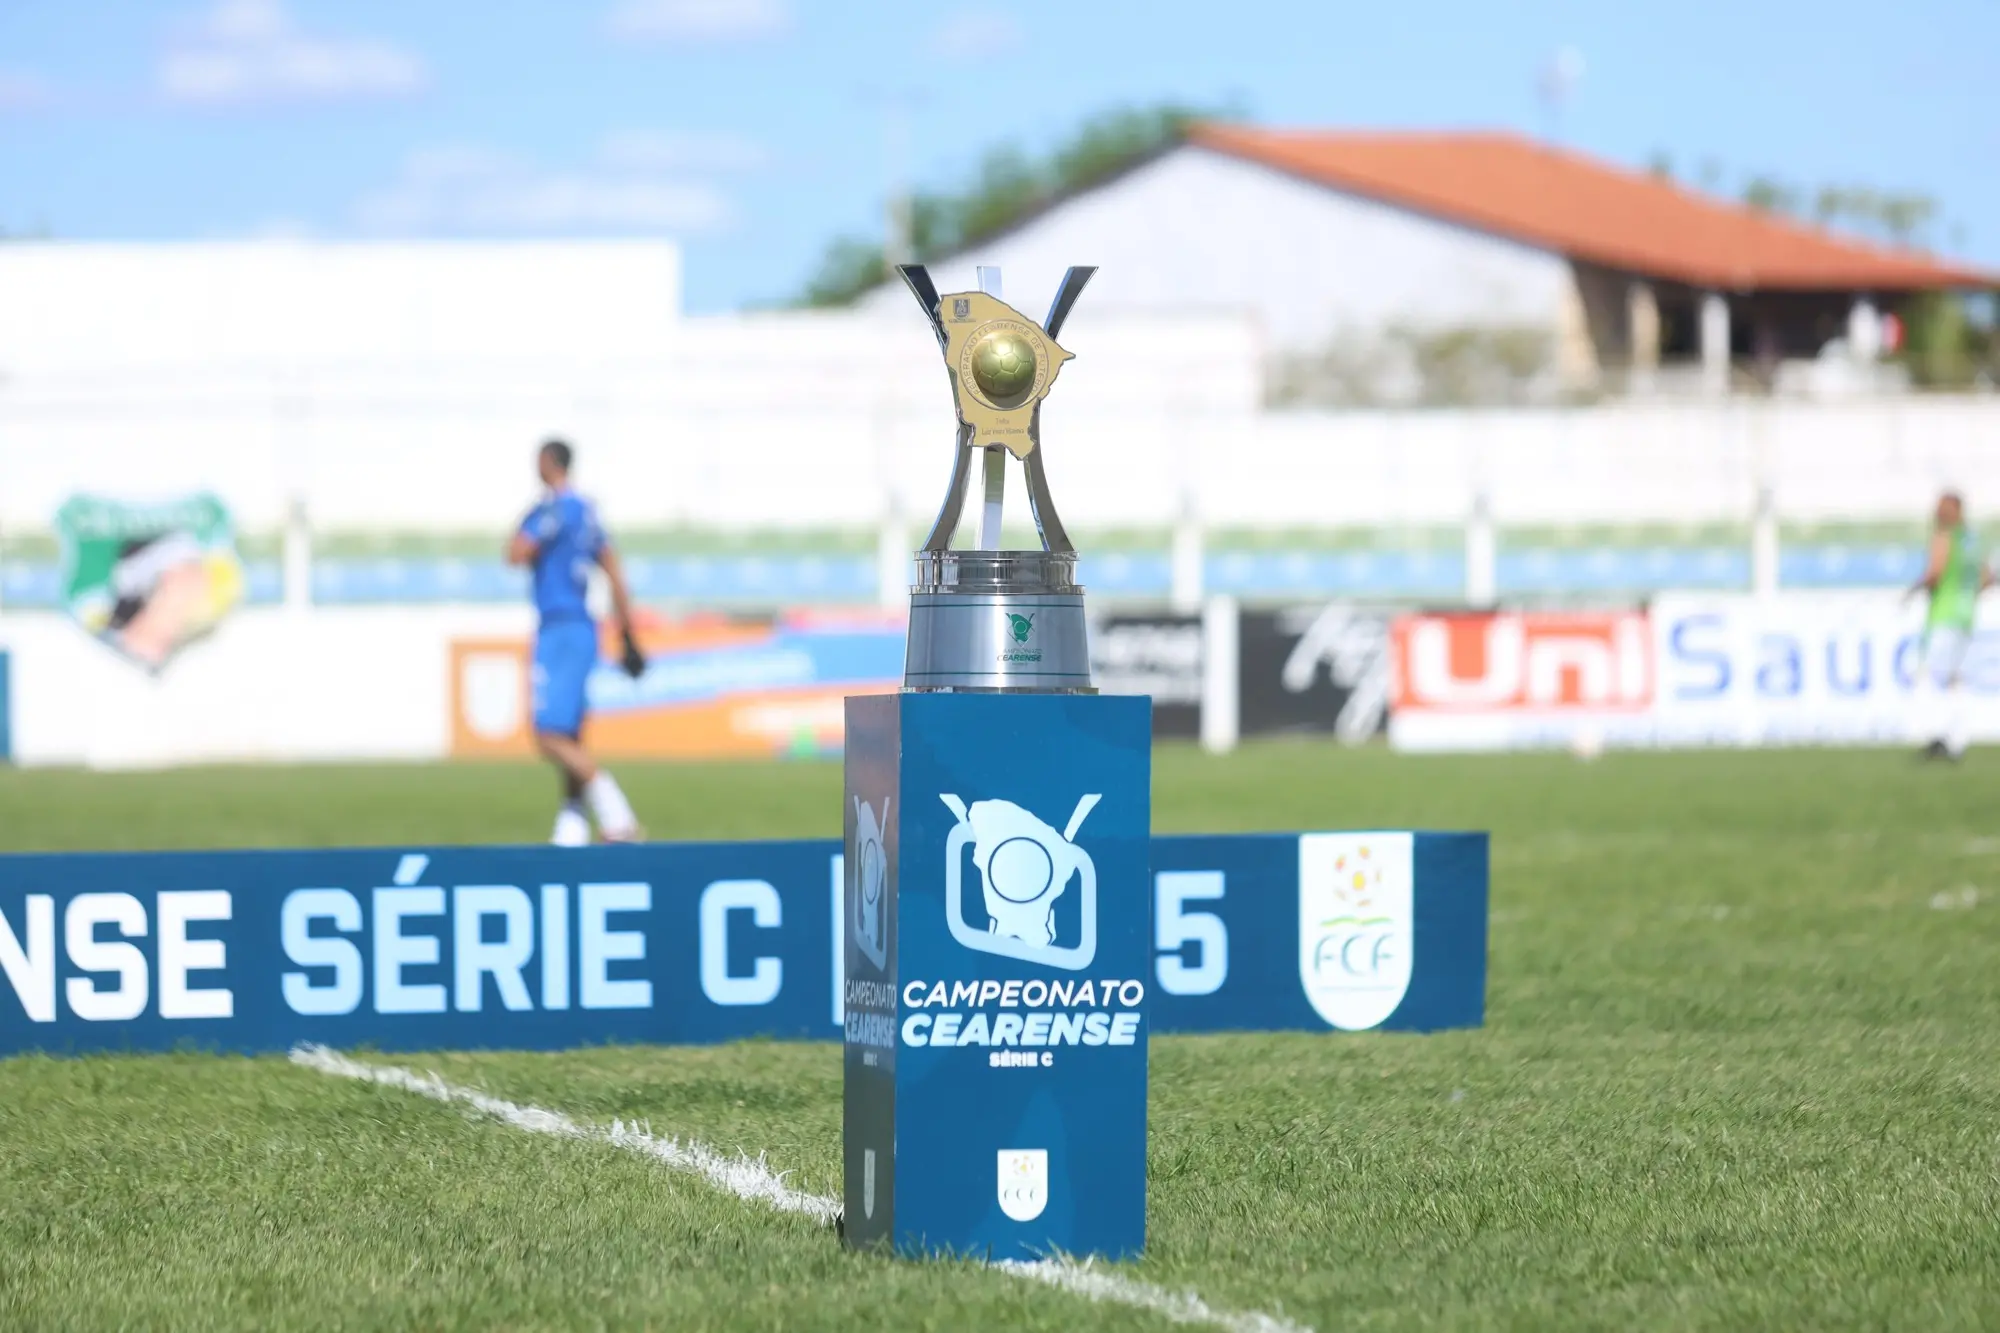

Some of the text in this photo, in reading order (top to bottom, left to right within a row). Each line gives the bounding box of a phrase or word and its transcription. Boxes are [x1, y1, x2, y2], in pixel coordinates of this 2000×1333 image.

[0, 854, 1229, 1022] NSE SÉRIE C 5
[844, 978, 897, 1010] CAMPEONATO
[902, 979, 1145, 1008] CAMPEONATO
[844, 1011, 896, 1049] CEARENSE
[901, 1012, 1141, 1047] CEARENSE
[989, 1048, 1053, 1067] SÉRIE C
